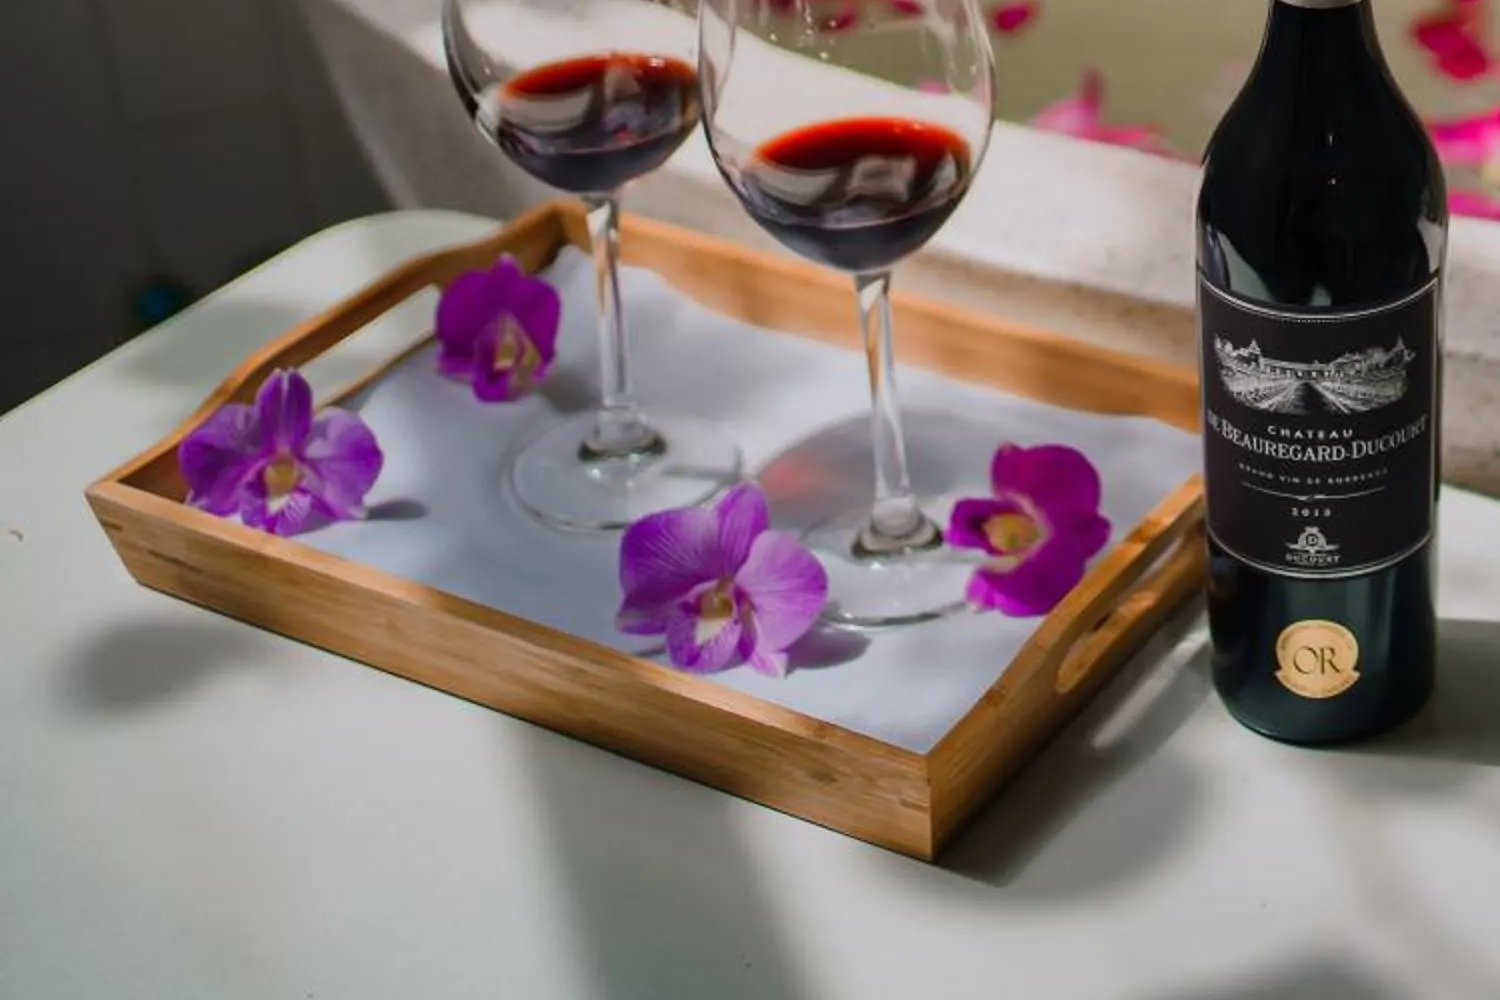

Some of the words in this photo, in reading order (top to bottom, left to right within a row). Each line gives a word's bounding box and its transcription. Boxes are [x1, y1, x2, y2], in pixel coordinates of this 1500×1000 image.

[1223, 414, 1428, 461] BEAUREGARD-DUCOURT
[1266, 425, 1354, 440] CHATEAU
[1279, 473, 1301, 484] VIN
[1291, 644, 1342, 676] OR
